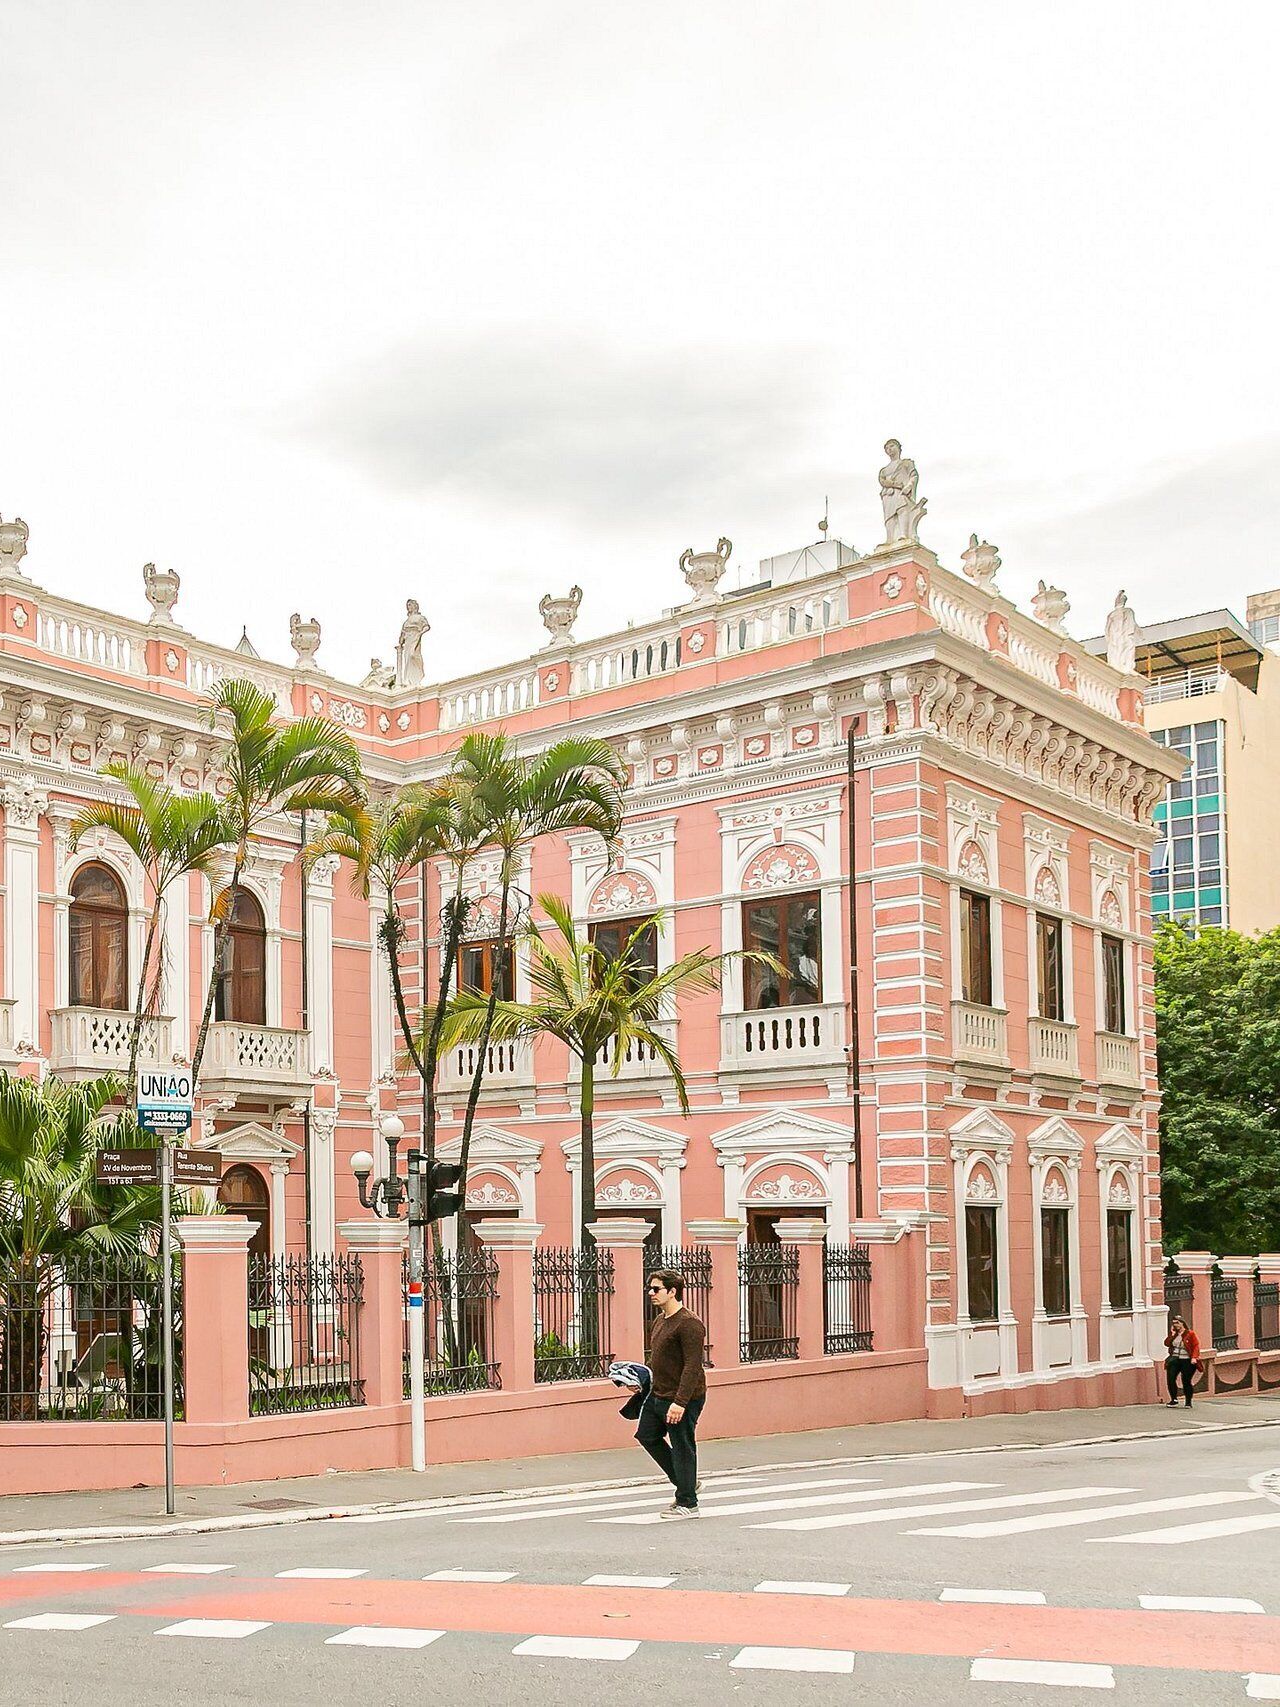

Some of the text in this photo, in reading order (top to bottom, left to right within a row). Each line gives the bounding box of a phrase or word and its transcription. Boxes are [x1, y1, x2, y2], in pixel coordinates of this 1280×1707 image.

[103, 1152, 120, 1161] Praça
[103, 1164, 152, 1172] XV de Novembro
